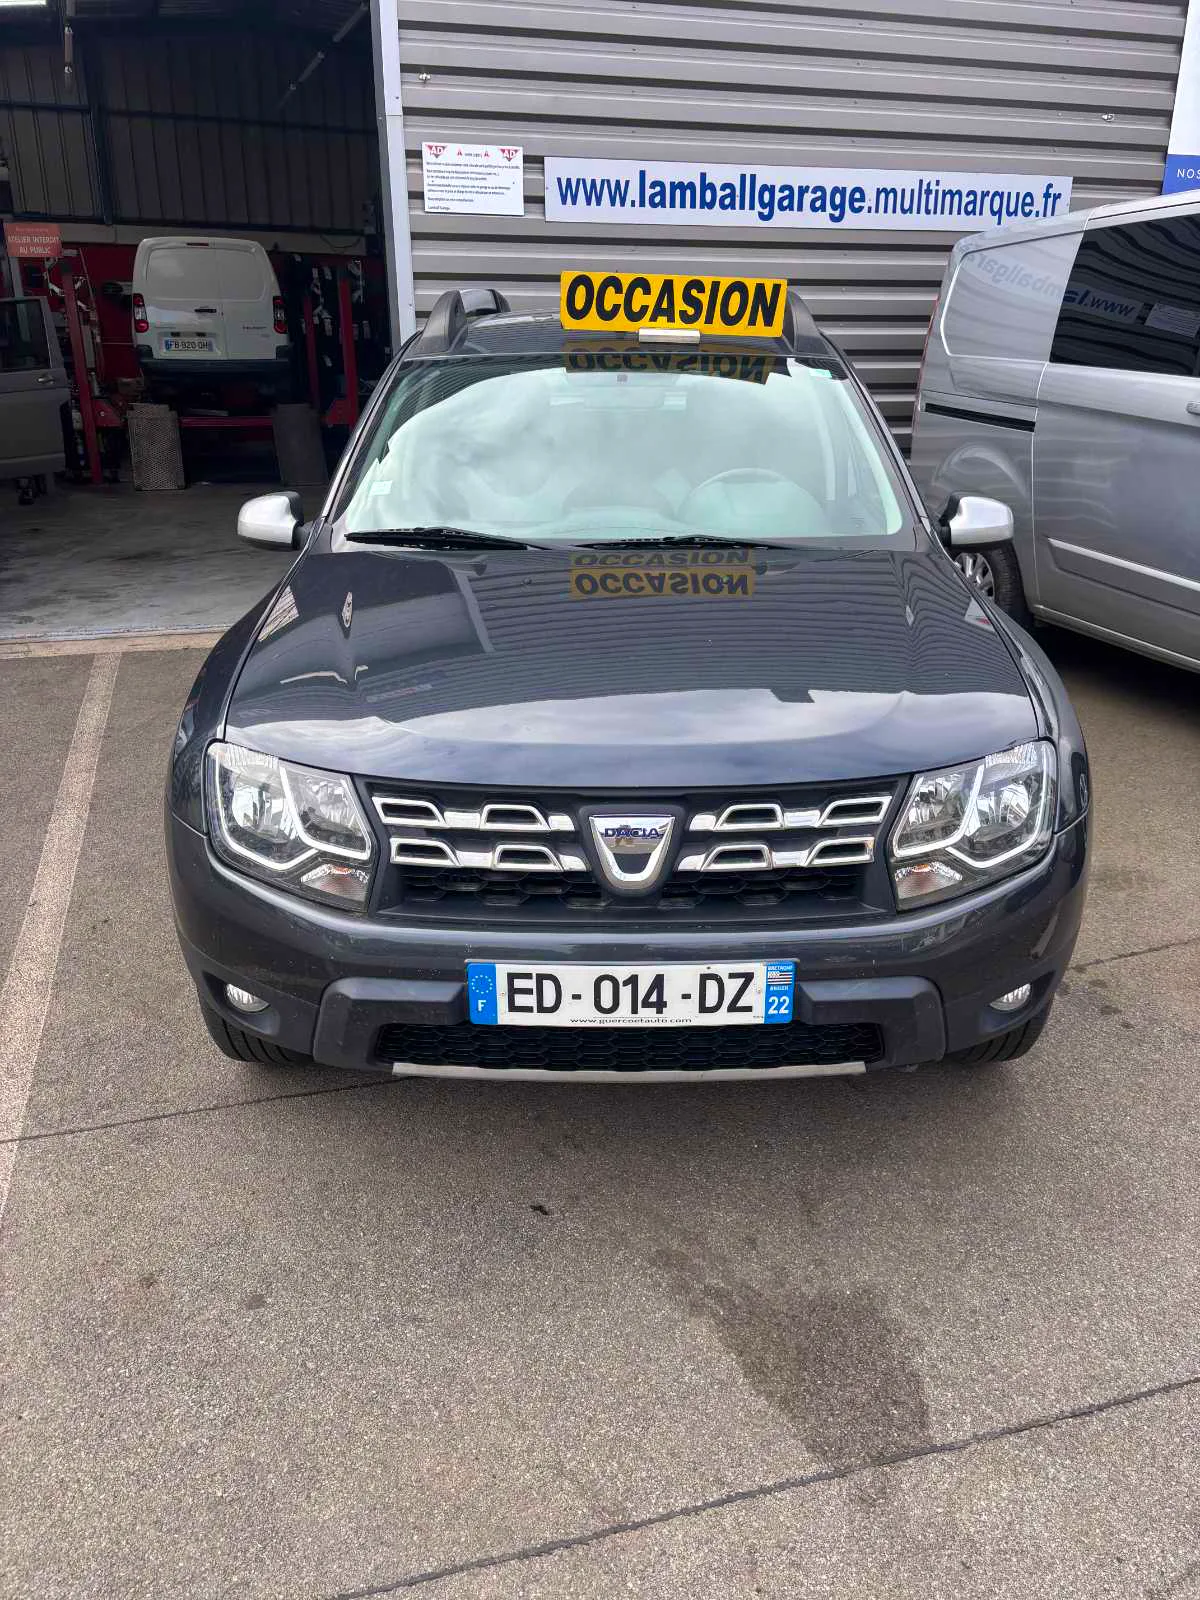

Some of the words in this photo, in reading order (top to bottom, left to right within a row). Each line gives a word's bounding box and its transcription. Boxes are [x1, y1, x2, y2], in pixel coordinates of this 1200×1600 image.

[556, 169, 1061, 225] www.lamballgarage.multimarque.fr
[566, 274, 782, 327] OCCASION
[604, 827, 660, 838] DACIA
[477, 1000, 485, 1012] F
[767, 996, 790, 1015] 22
